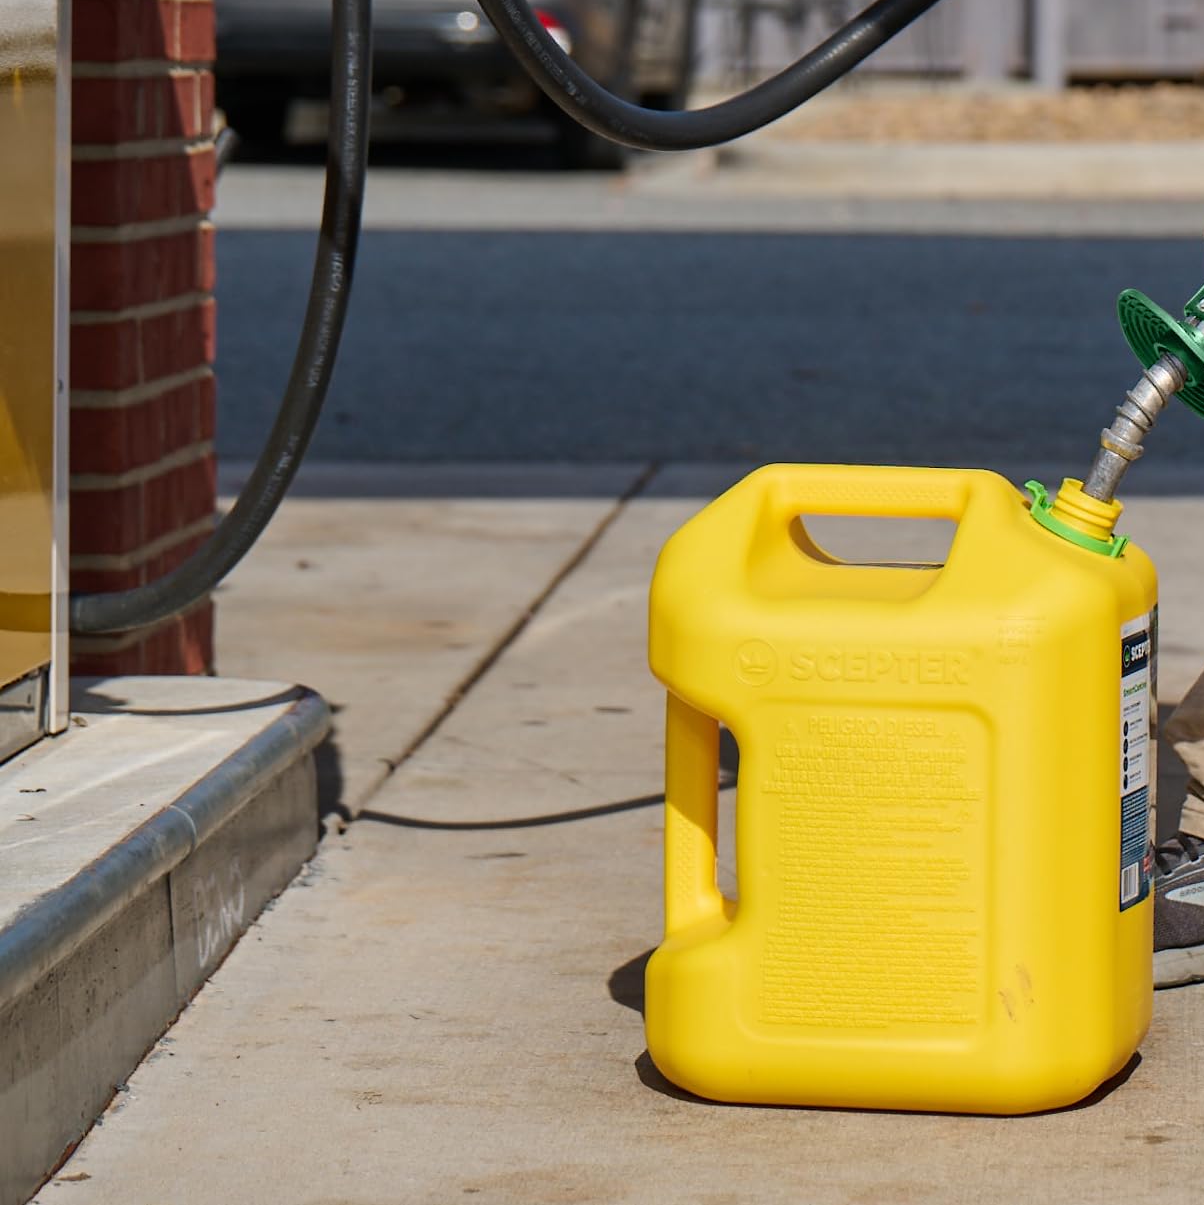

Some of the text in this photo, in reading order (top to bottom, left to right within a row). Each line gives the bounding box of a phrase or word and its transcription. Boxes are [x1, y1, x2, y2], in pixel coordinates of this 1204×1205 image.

[790, 651, 970, 685] SCEPTER
[808, 716, 943, 737] PELIGRO DIESEL
